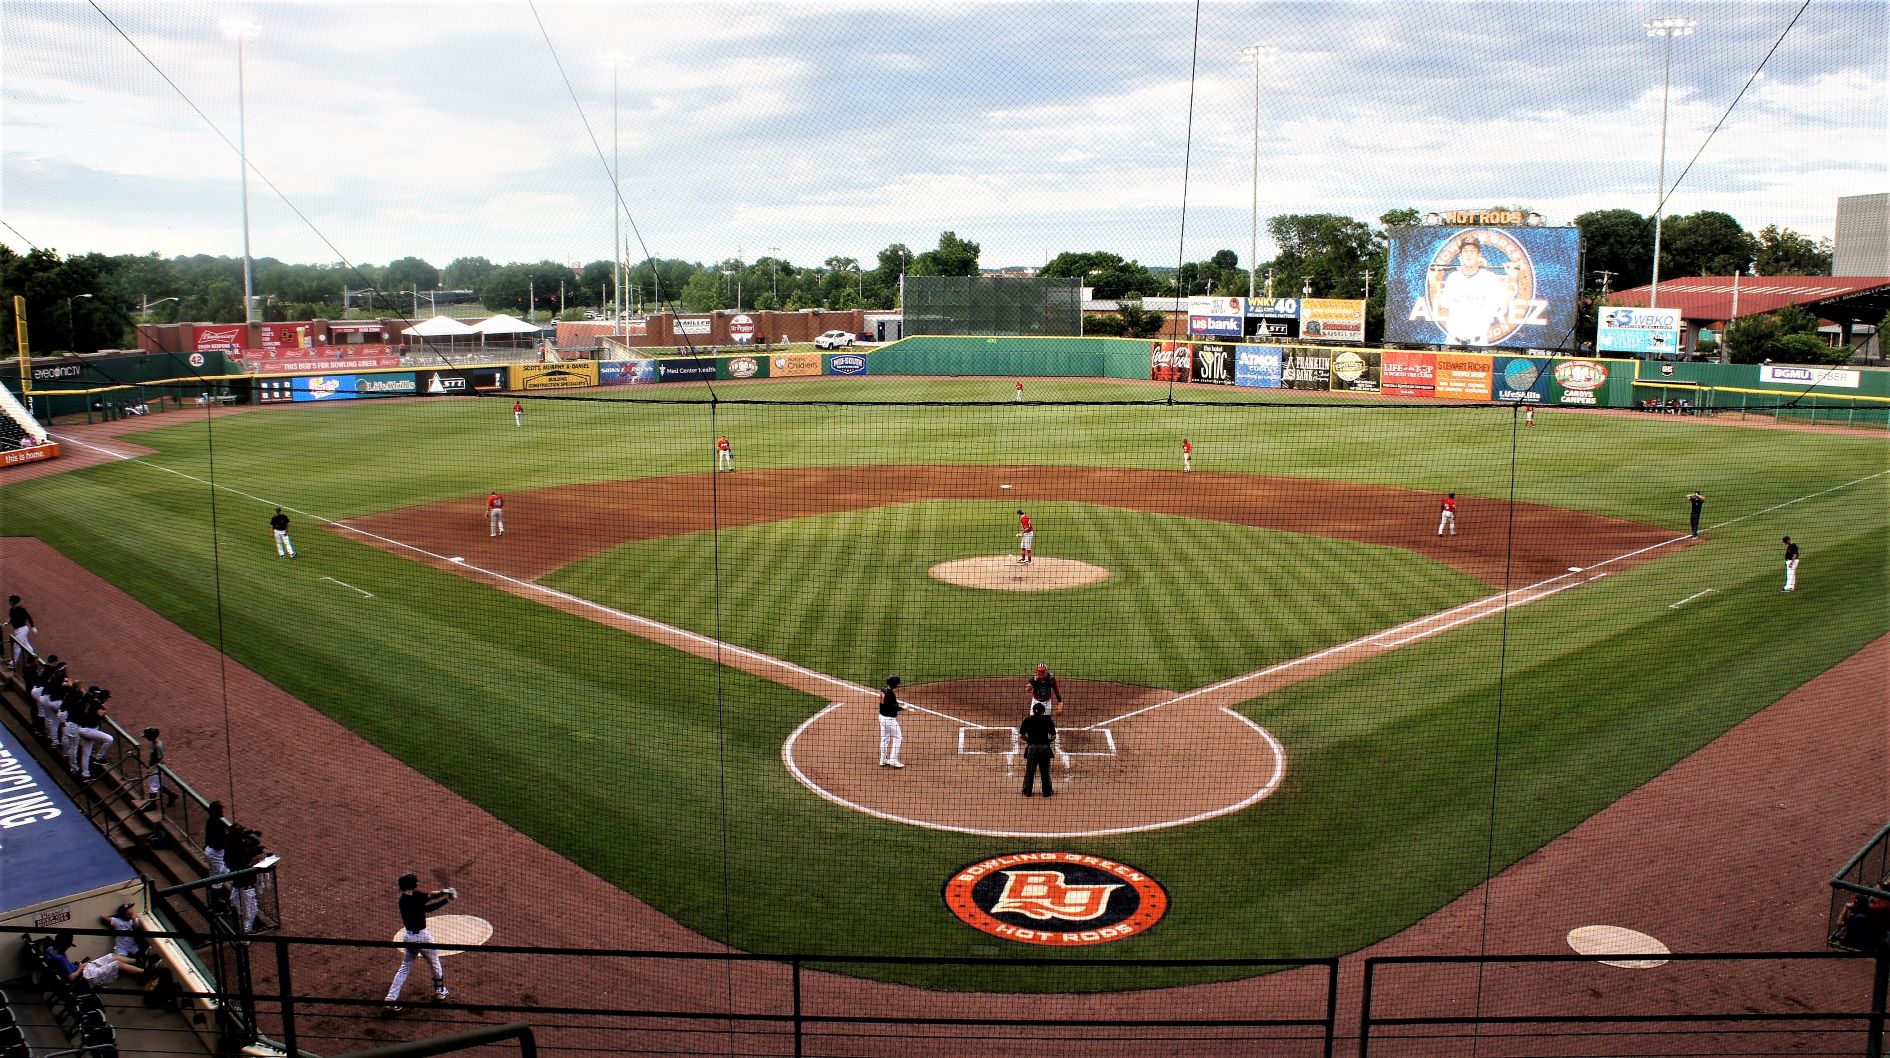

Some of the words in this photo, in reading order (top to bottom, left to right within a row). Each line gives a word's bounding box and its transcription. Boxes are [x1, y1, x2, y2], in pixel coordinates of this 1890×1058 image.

[1447, 212, 1475, 224] HOT
[1480, 211, 1522, 224] RODS
[1248, 298, 1276, 306] WNKY
[1275, 298, 1296, 314] 40
[1634, 315, 1674, 326] WBKO
[190, 355, 202, 364] 42
[1296, 356, 1330, 369] FRANKLIN
[1438, 361, 1467, 370] STEWART
[1296, 370, 1314, 382] BANK
[1773, 368, 1810, 378] BGMU
[1818, 372, 1848, 381] FIBER
[1499, 391, 1540, 399] LifeSkills
[6, 455, 18, 463] this
[958, 852, 1058, 881] BOWLING
[1065, 853, 1146, 882] GREEN
[996, 924, 1054, 942] HOT
[1062, 922, 1134, 942] RODS
